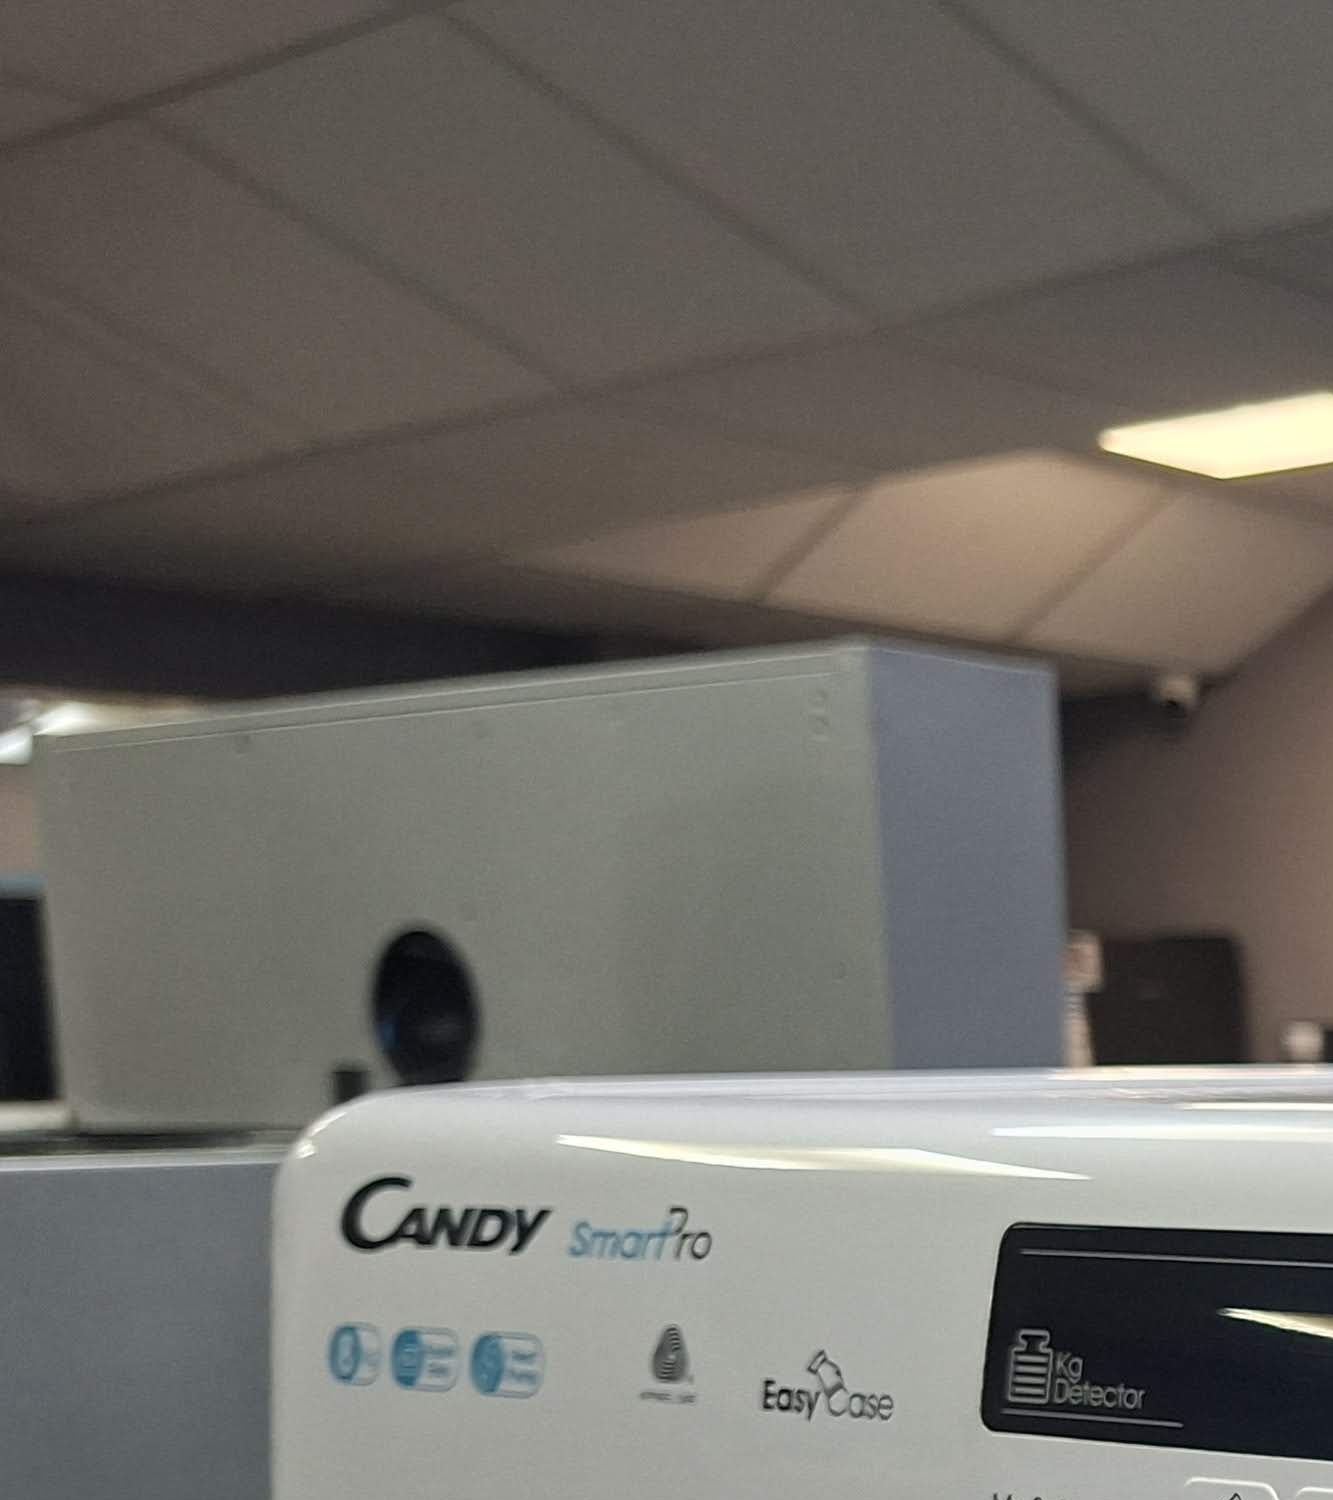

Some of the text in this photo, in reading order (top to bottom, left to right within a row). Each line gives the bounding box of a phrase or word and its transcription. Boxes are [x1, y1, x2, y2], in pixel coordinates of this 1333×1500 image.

[341, 1176, 553, 1256] CANDY
[567, 1206, 713, 1261] SmartPro
[1054, 1350, 1084, 1383] Kg
[1053, 1377, 1147, 1410] Detector
